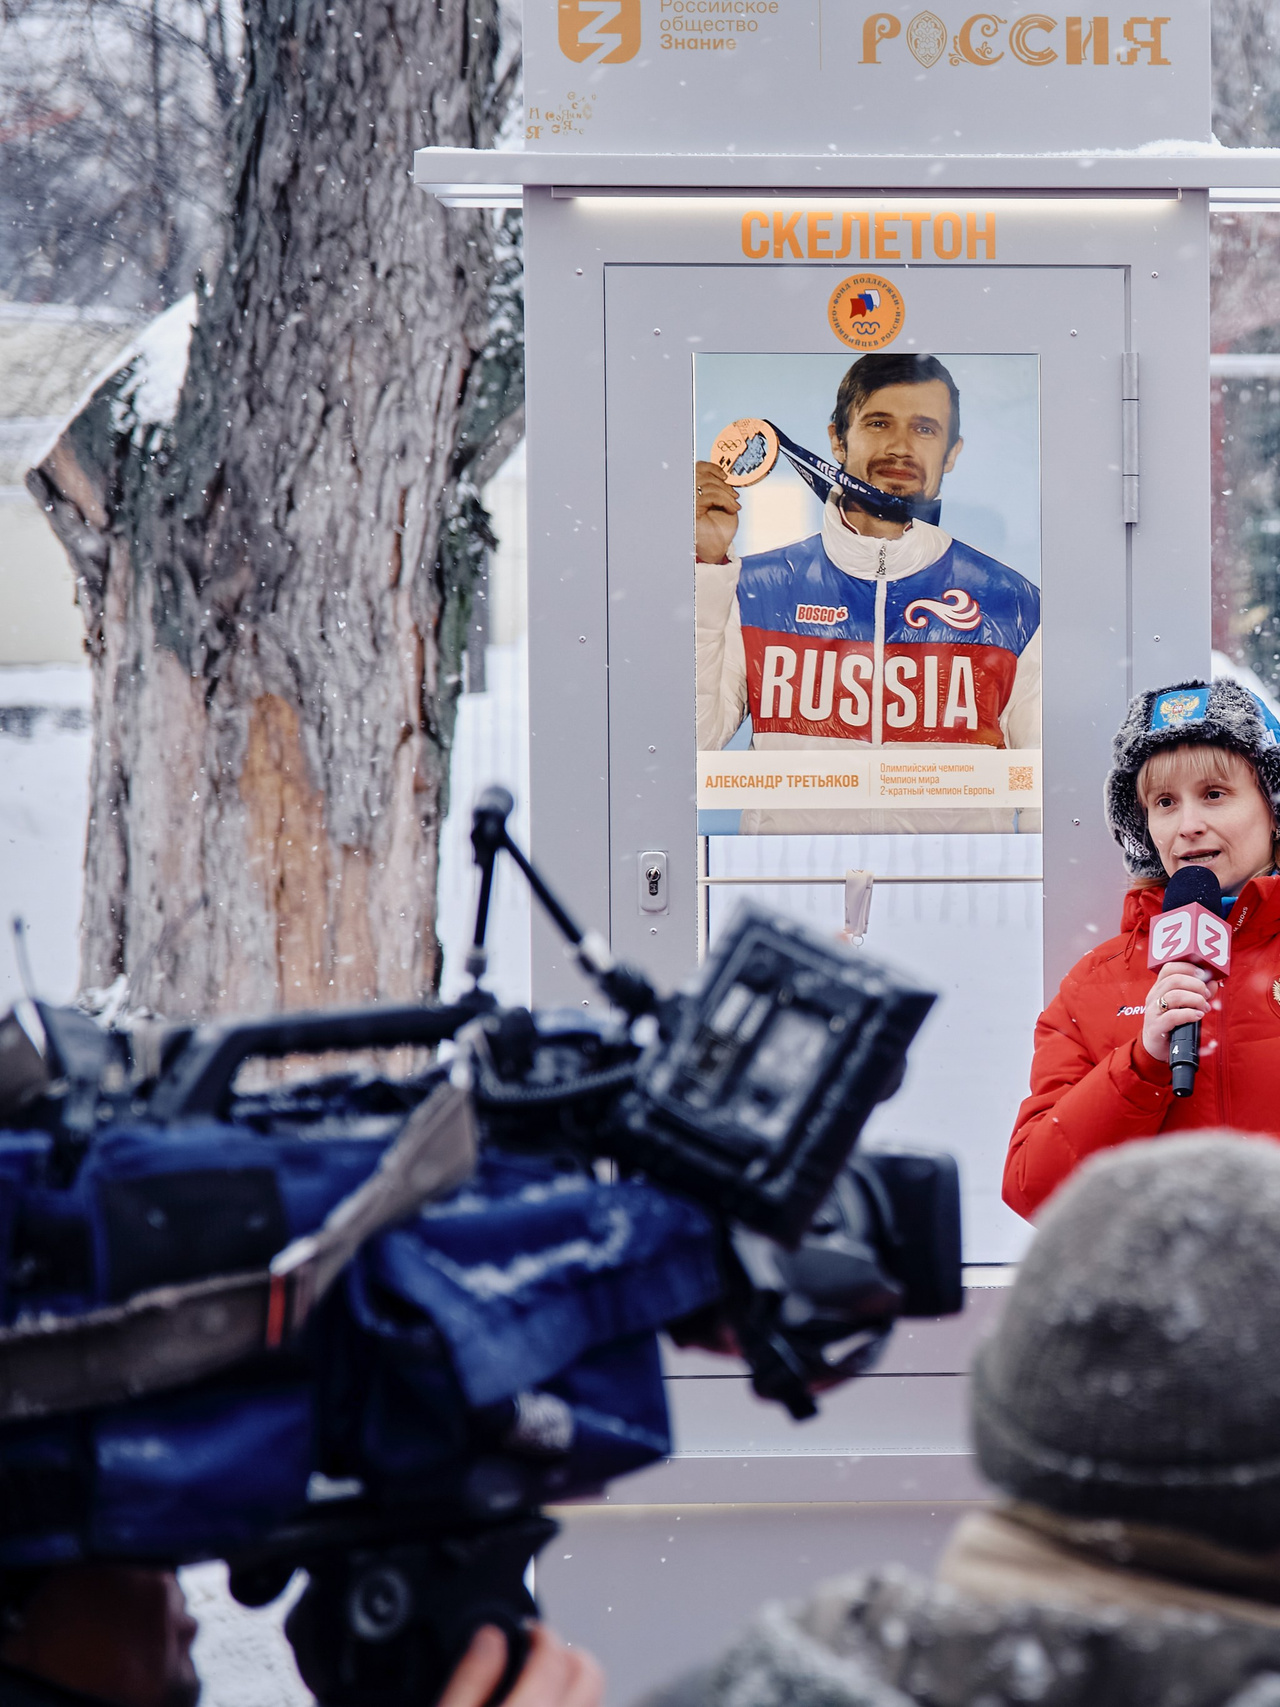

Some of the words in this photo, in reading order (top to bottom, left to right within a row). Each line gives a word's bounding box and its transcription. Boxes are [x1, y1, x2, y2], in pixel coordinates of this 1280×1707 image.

[660, 16, 759, 34] общество
[660, 34, 737, 50] Знание
[857, 10, 1173, 68] РОССИЯ
[740, 209, 997, 260] СКЕЛЕТОН
[797, 606, 835, 623] BOSCO
[760, 645, 979, 730] RUSSIA
[880, 762, 937, 773] Олимпийский
[938, 764, 975, 773] чемпион
[705, 775, 783, 789] АЛЕКСАНДР
[787, 775, 859, 788] ТРЕТЬЯКОВ
[880, 774, 918, 784] Чемпион
[918, 776, 940, 785] мира
[880, 785, 925, 797] 2-кратный
[926, 787, 962, 796] чемпион
[963, 785, 995, 797] Европы
[1172, 1045, 1179, 1054] 4
